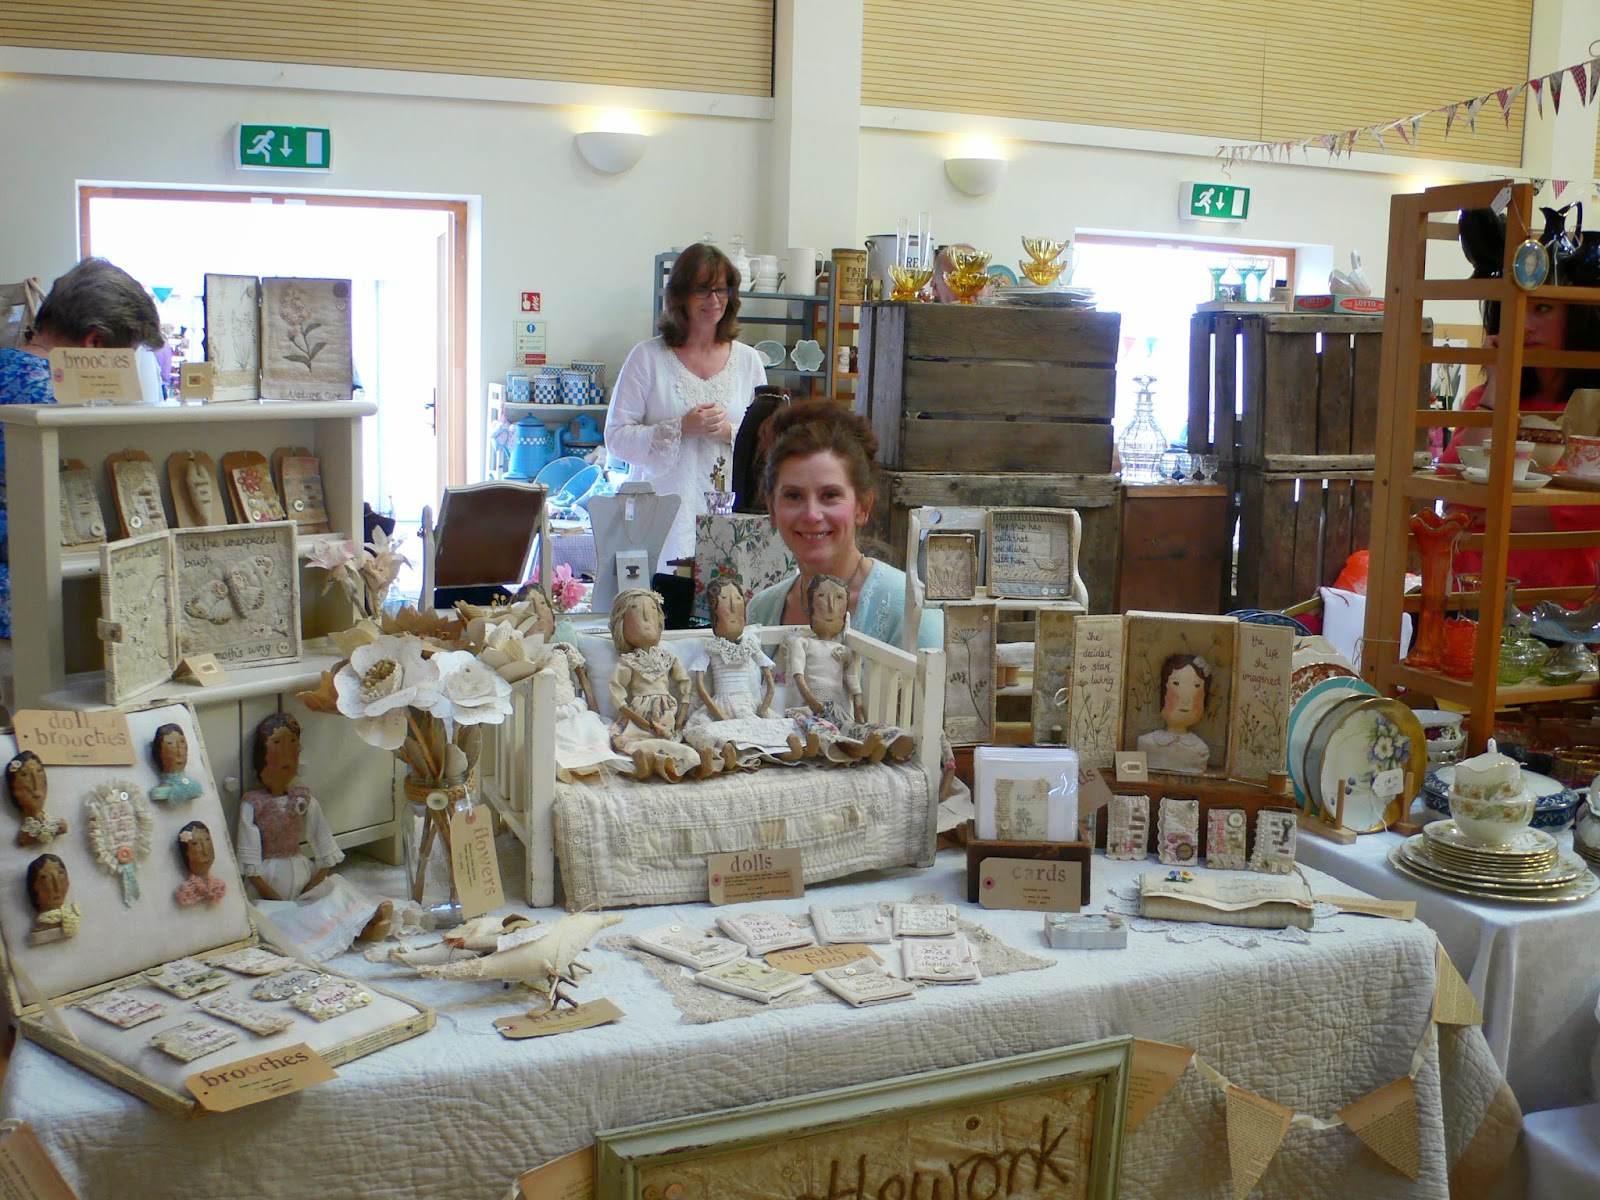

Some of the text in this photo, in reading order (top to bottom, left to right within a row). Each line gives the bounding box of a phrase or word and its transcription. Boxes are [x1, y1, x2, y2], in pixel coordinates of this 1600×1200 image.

[1029, 521, 1041, 531] has
[181, 530, 278, 552] like the unexpected
[184, 556, 212, 569] brush
[1251, 635, 1264, 647] the
[248, 643, 271, 658] wing
[1083, 648, 1113, 658] decided
[1265, 646, 1279, 660] life
[1079, 662, 1087, 673] to
[1092, 662, 1111, 673] start
[1091, 673, 1114, 693] living
[1242, 670, 1282, 691] imagined
[48, 710, 90, 730] doll
[34, 726, 127, 748] brooches
[473, 826, 496, 897] flowers
[730, 853, 773, 873] dolls
[1011, 863, 1067, 883] cards
[781, 946, 843, 961] needle
[806, 950, 868, 966] books
[315, 990, 347, 1006] trust
[199, 1051, 310, 1088] brooches
